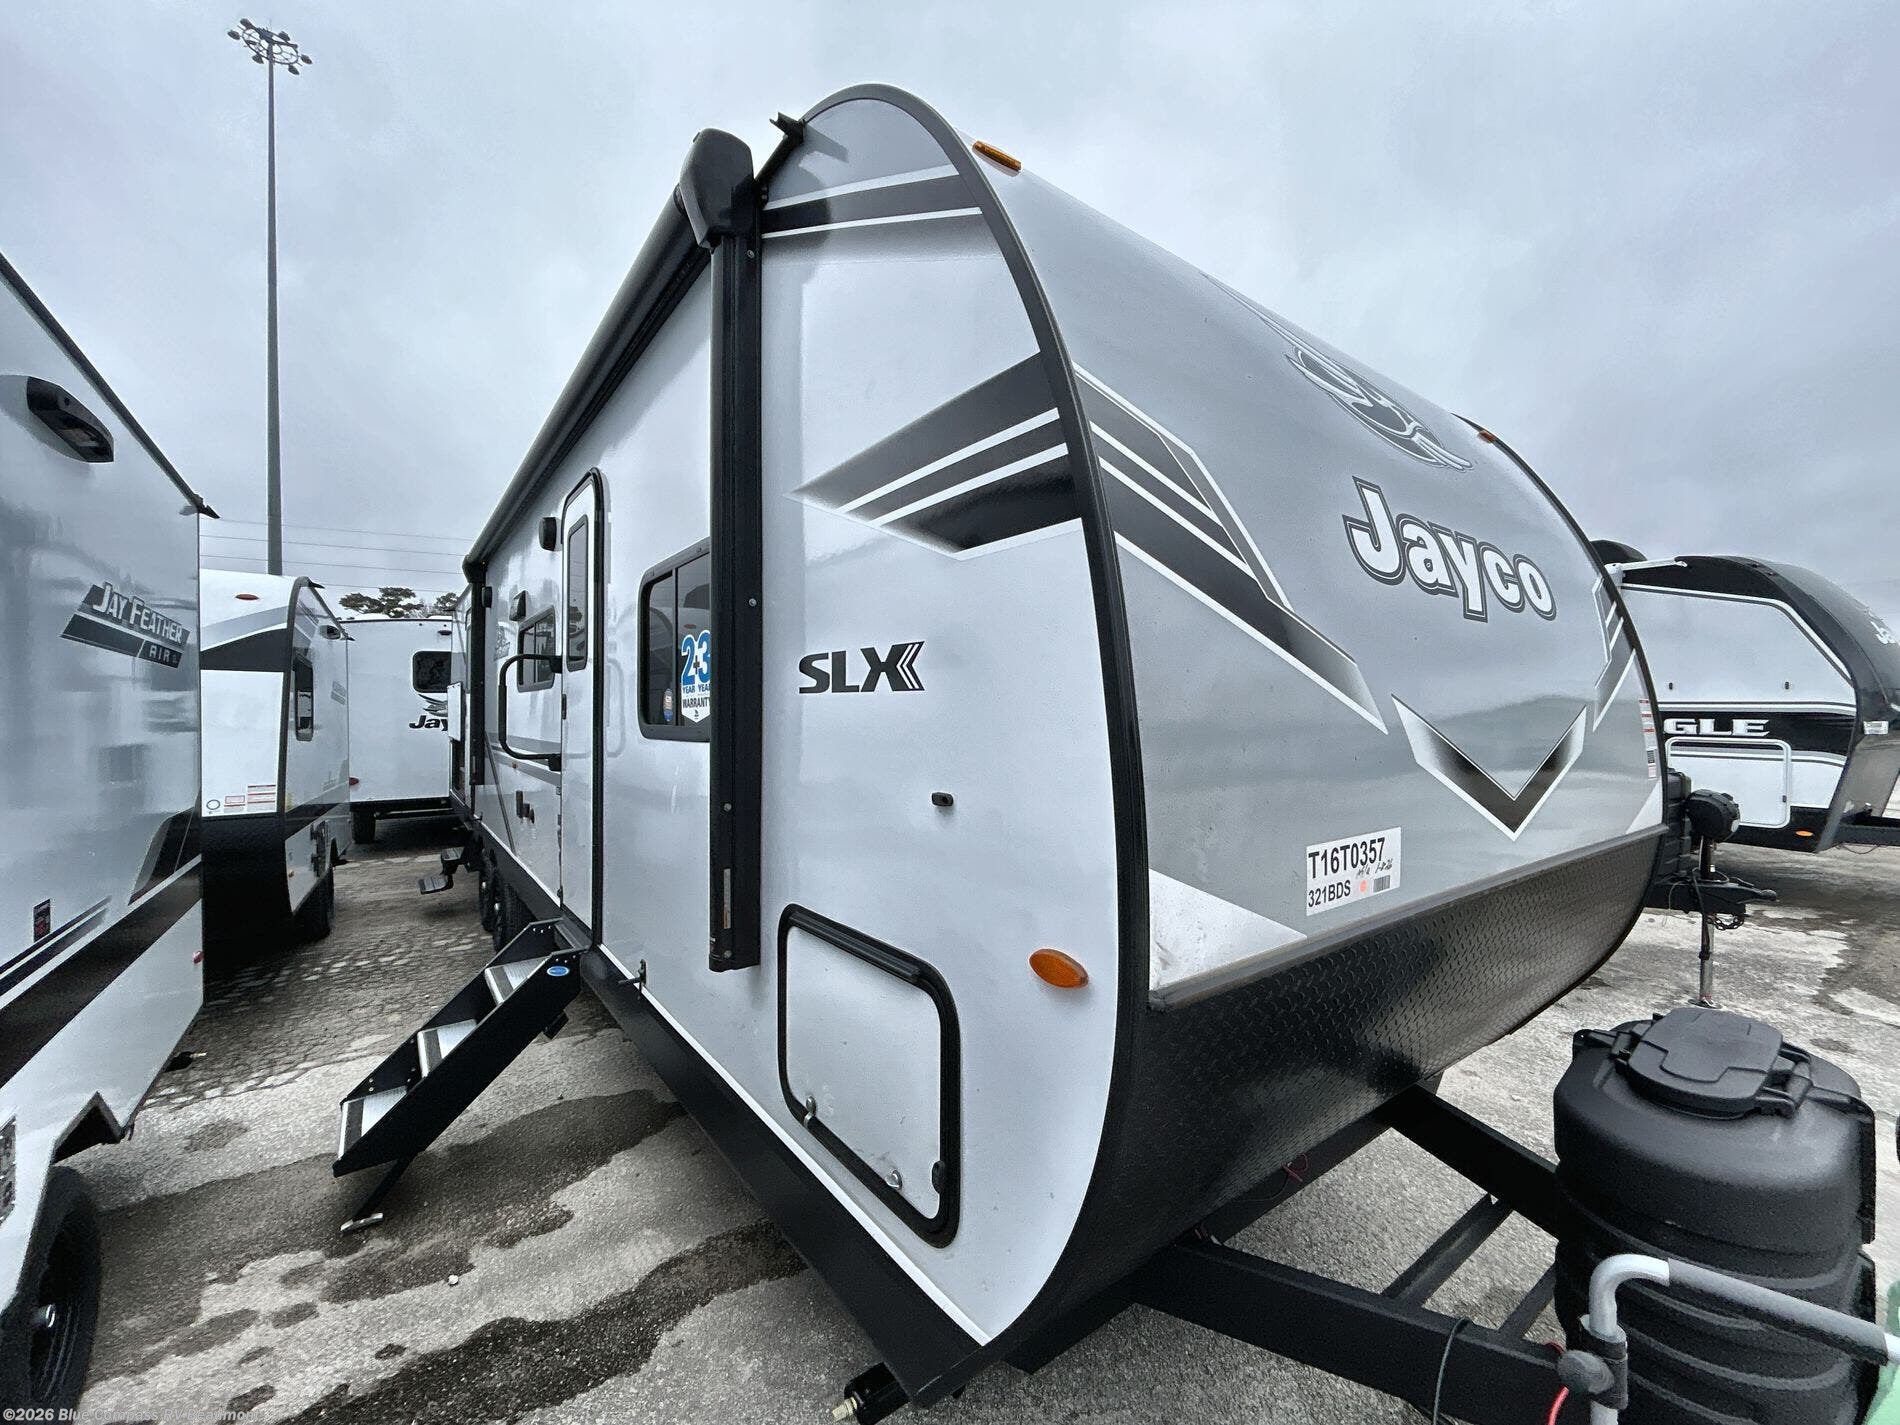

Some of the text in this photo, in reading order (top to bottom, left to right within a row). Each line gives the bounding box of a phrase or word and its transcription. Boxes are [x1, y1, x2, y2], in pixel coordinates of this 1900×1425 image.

[1342, 476, 1557, 623] Jayco
[93, 581, 184, 644] JAY FEATHER
[149, 645, 171, 663] AIR
[799, 641, 925, 693] SLX
[682, 697, 711, 709] WARRANT
[409, 714, 449, 732] Jay
[1663, 718, 1770, 737] GLE
[1308, 837, 1386, 879] T16T0357
[1308, 879, 1351, 908] 321BDS
